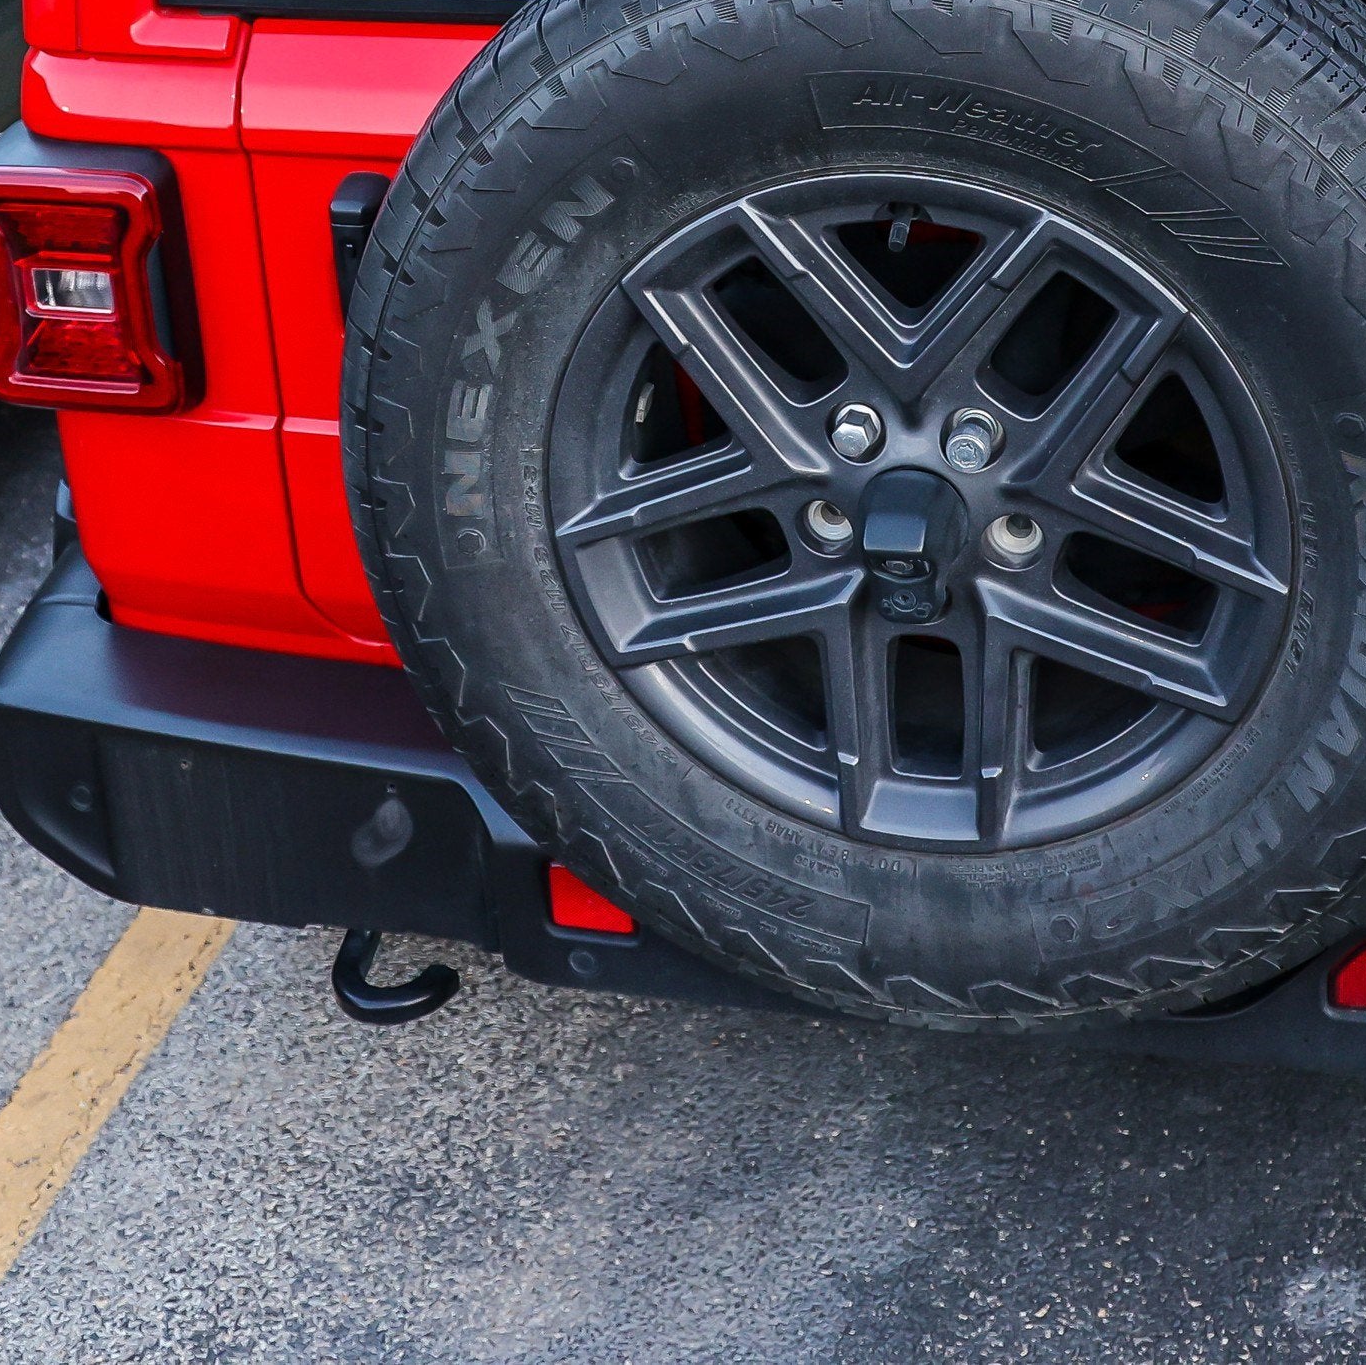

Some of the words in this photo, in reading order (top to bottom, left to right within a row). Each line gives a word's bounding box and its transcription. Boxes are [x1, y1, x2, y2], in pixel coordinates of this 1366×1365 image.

[852, 83, 1104, 153] All-Weather
[950, 119, 1086, 171] Performance
[441, 175, 616, 517] NEXEN
